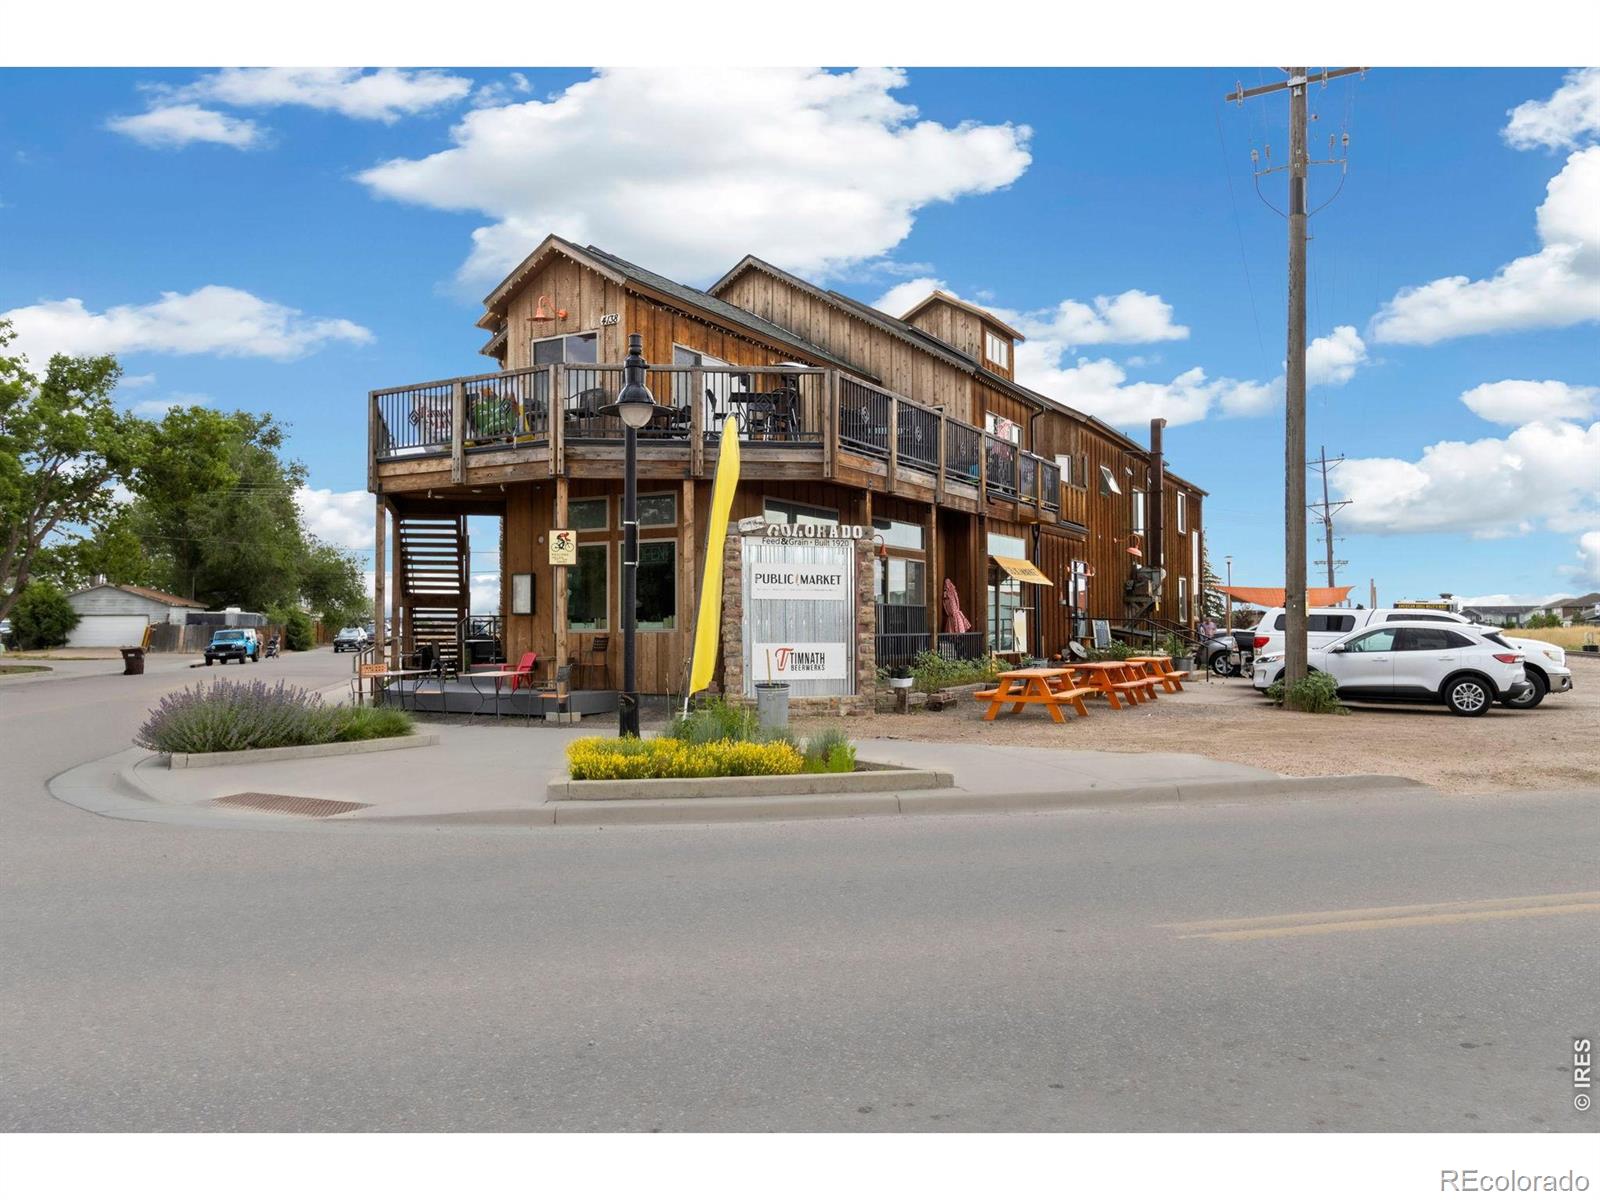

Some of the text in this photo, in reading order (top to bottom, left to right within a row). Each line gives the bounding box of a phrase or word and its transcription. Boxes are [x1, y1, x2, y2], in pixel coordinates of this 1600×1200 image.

[767, 524, 863, 538] COLORADO
[814, 538, 830, 547] Built
[832, 539, 849, 547] 1920
[754, 573, 841, 585] PUBLIC MARKET
[790, 652, 825, 664] TIMNATH
